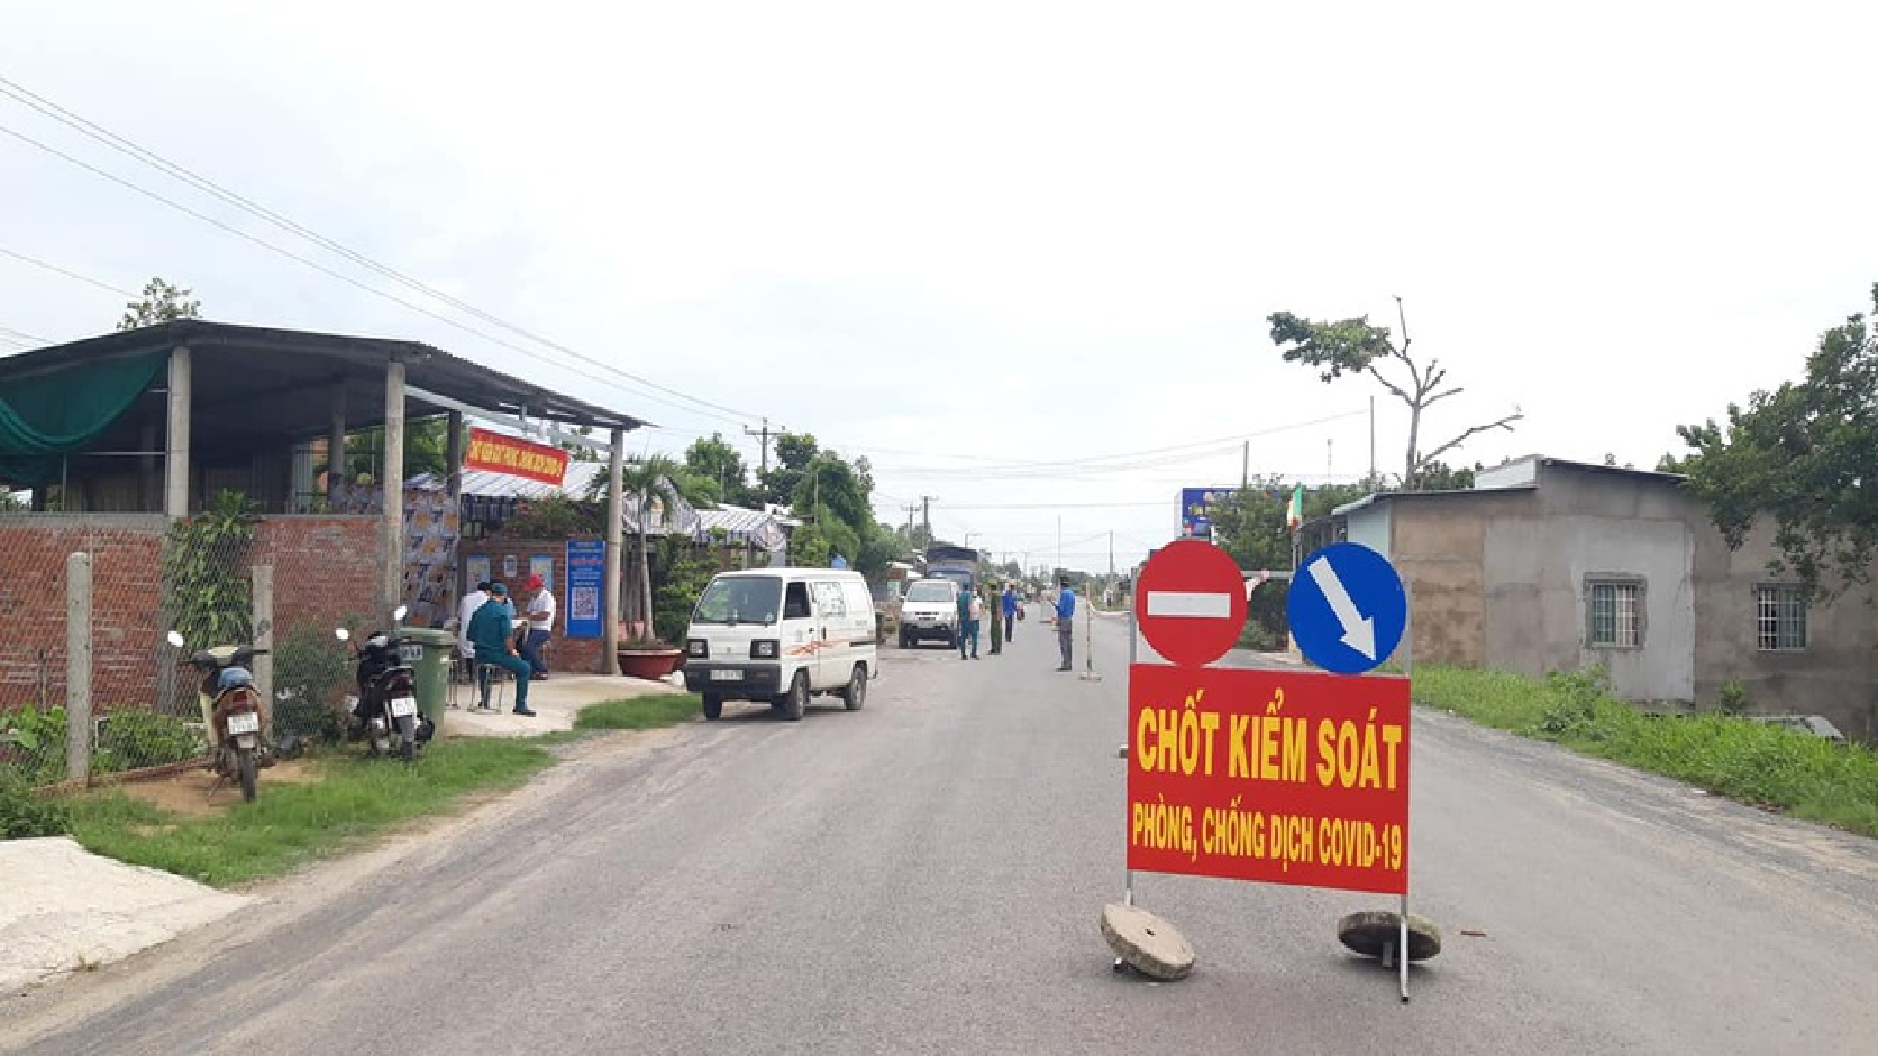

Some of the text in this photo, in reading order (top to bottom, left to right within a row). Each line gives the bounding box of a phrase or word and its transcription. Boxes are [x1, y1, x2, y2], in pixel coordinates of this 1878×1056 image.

[1137, 687, 1402, 789] CHỐT KIỂM SOÁT
[1132, 792, 1402, 872] PHÒNG, CHỐNG DỊCH COVID-19
